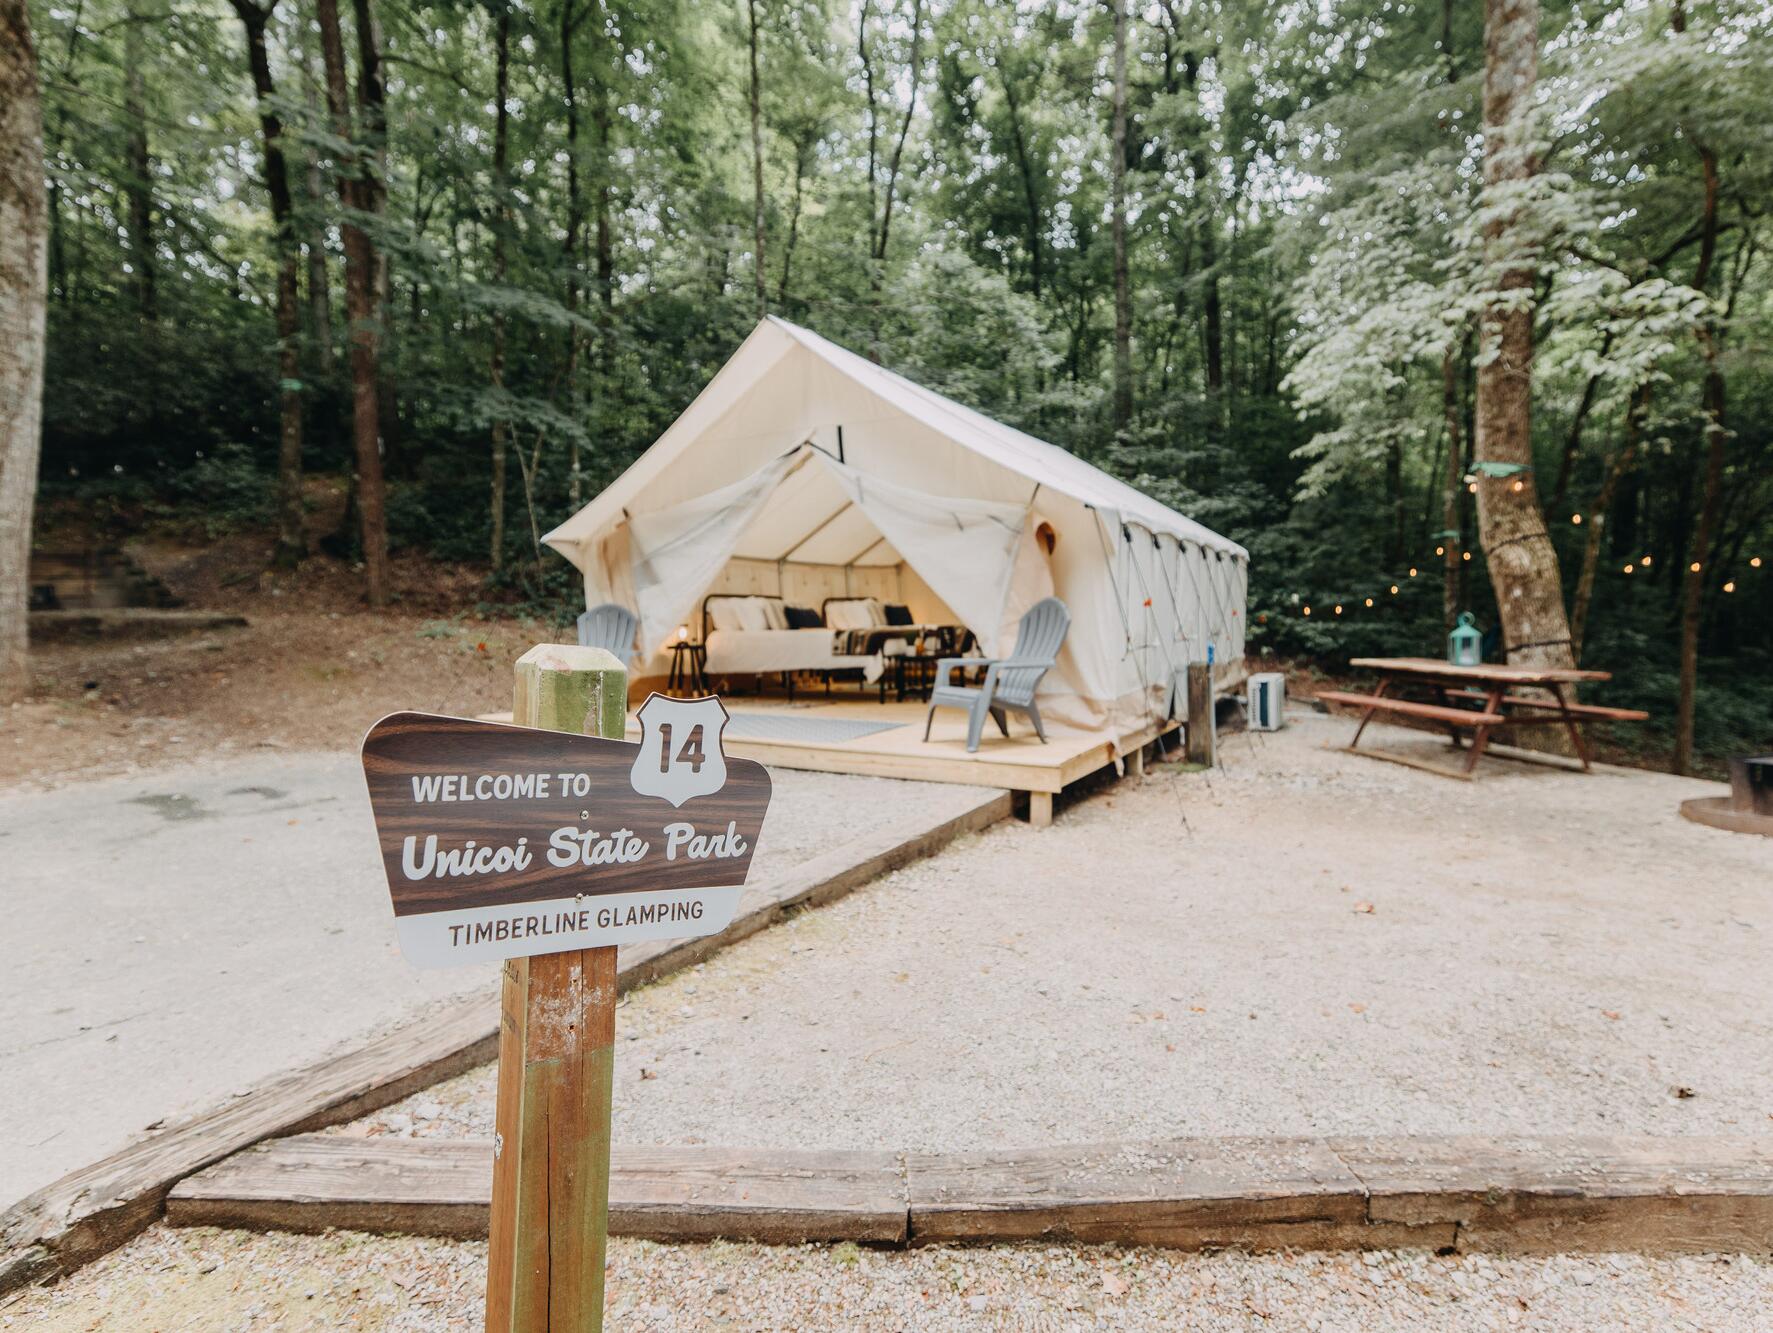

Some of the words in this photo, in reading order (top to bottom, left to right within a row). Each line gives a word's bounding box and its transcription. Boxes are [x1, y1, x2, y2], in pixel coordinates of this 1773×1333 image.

[659, 723, 706, 774] 14
[412, 773, 551, 802] WELCOME
[558, 773, 591, 797] TO
[402, 834, 532, 880] Unicoi
[546, 826, 649, 867] State
[663, 820, 747, 861] Park
[449, 910, 590, 947] TIMBERLINE
[597, 900, 704, 928] GLAMPING
